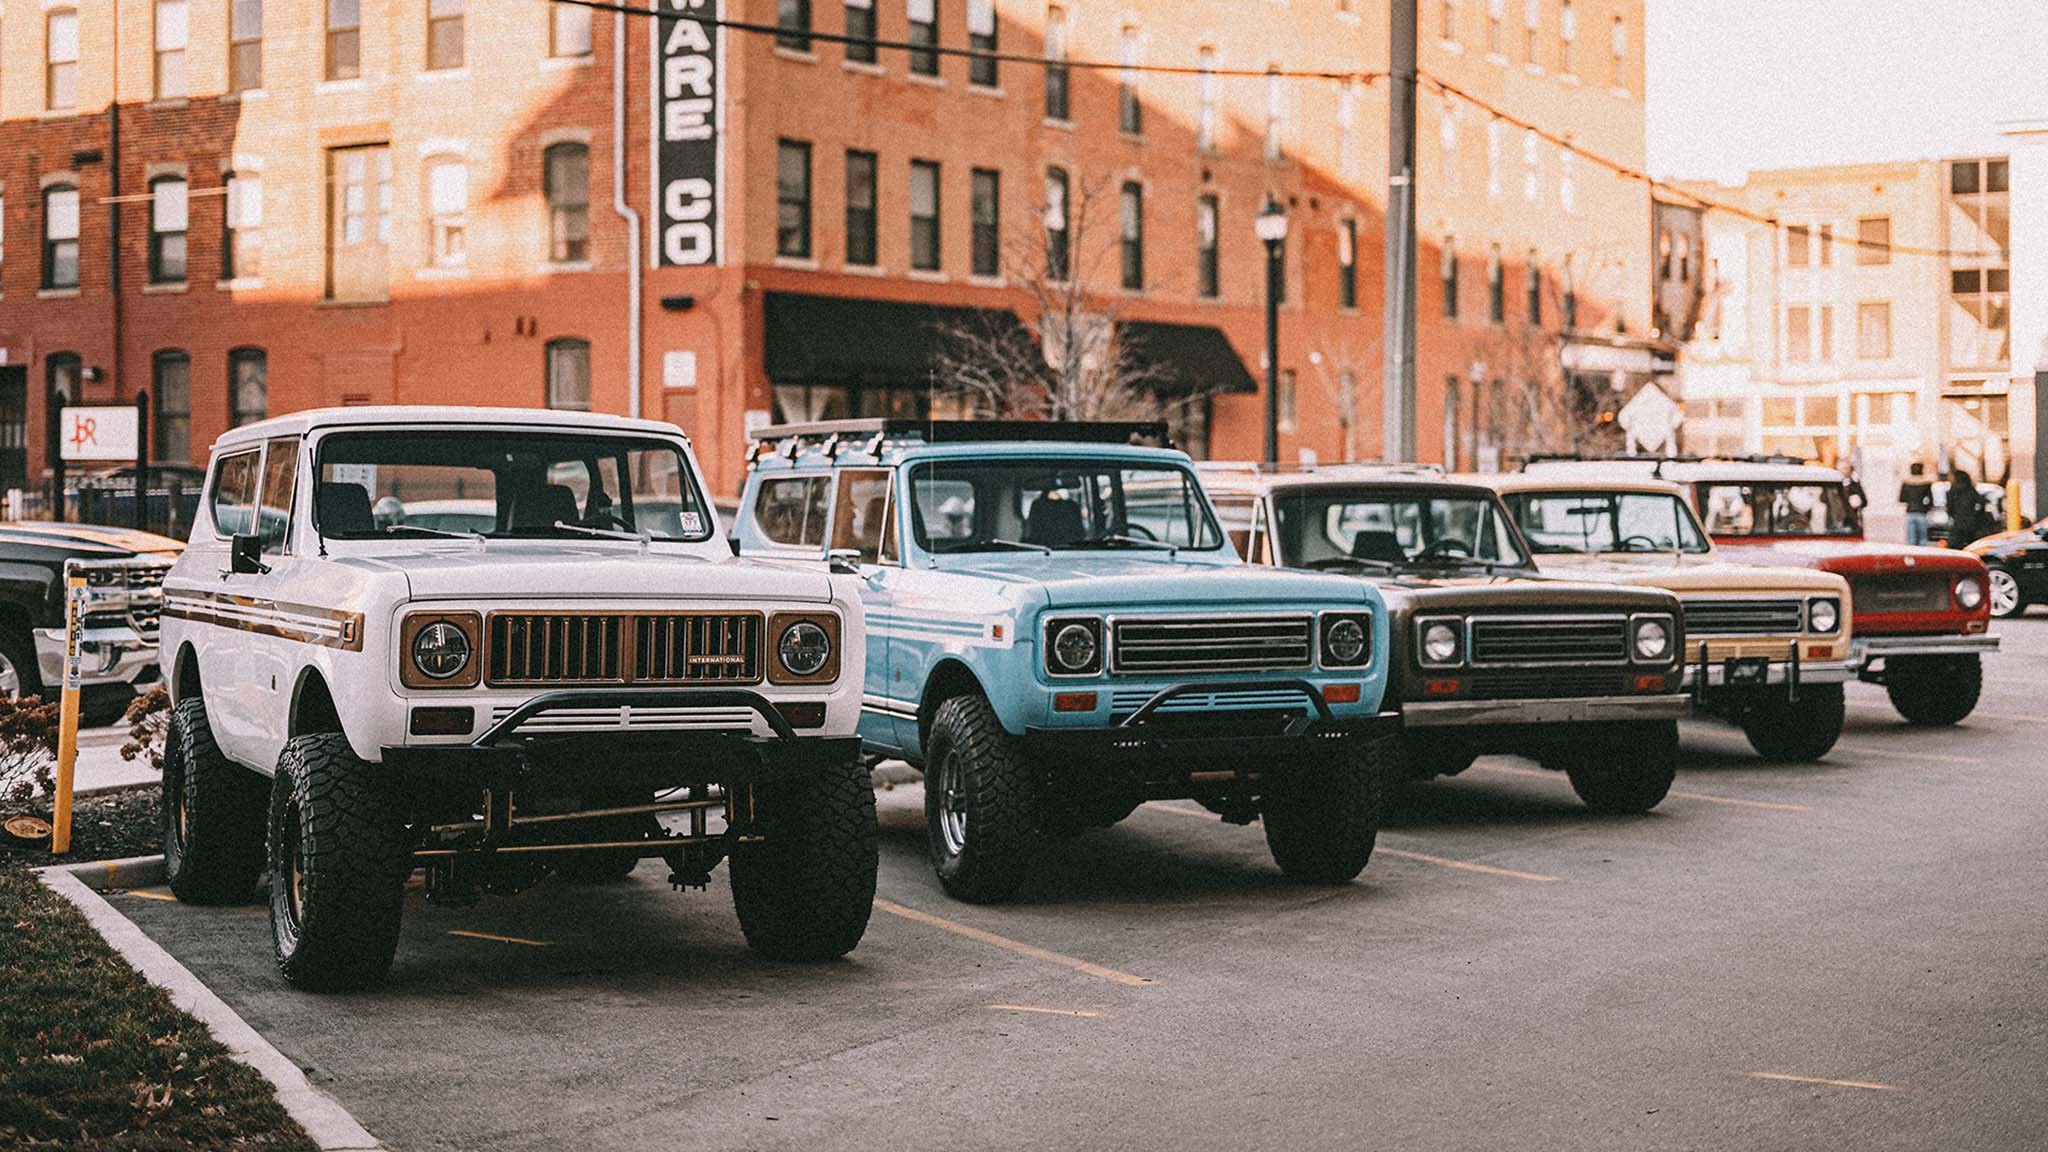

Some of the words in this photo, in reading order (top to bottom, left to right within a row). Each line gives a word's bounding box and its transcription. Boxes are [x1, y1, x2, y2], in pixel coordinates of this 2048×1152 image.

[664, 0, 714, 141] ARE
[664, 177, 713, 265] CO
[689, 656, 745, 664] INTERNATIONAL
